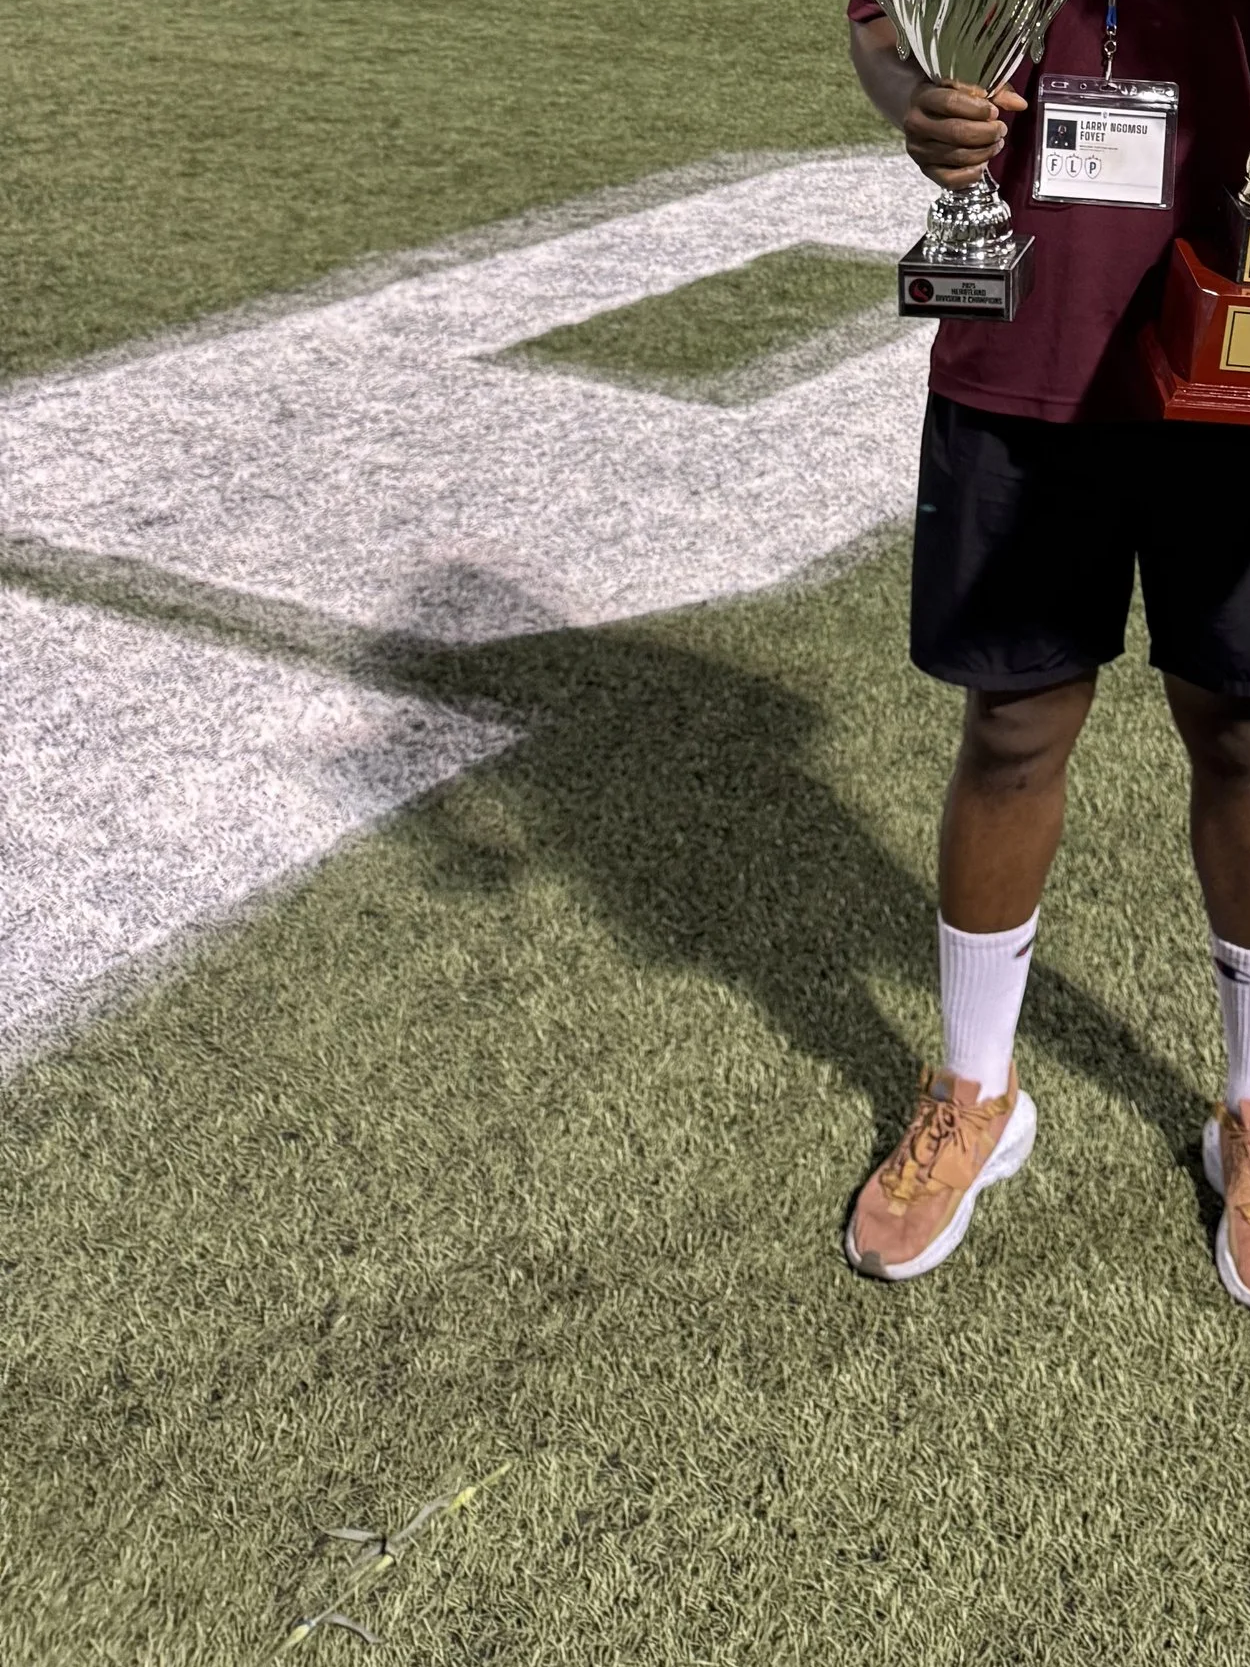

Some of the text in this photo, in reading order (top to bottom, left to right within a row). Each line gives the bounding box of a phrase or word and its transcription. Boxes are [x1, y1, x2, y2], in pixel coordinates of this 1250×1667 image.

[1080, 120, 1107, 131] LARRY
[1080, 131, 1106, 142] FOYET
[1051, 158, 1097, 174] F L P
